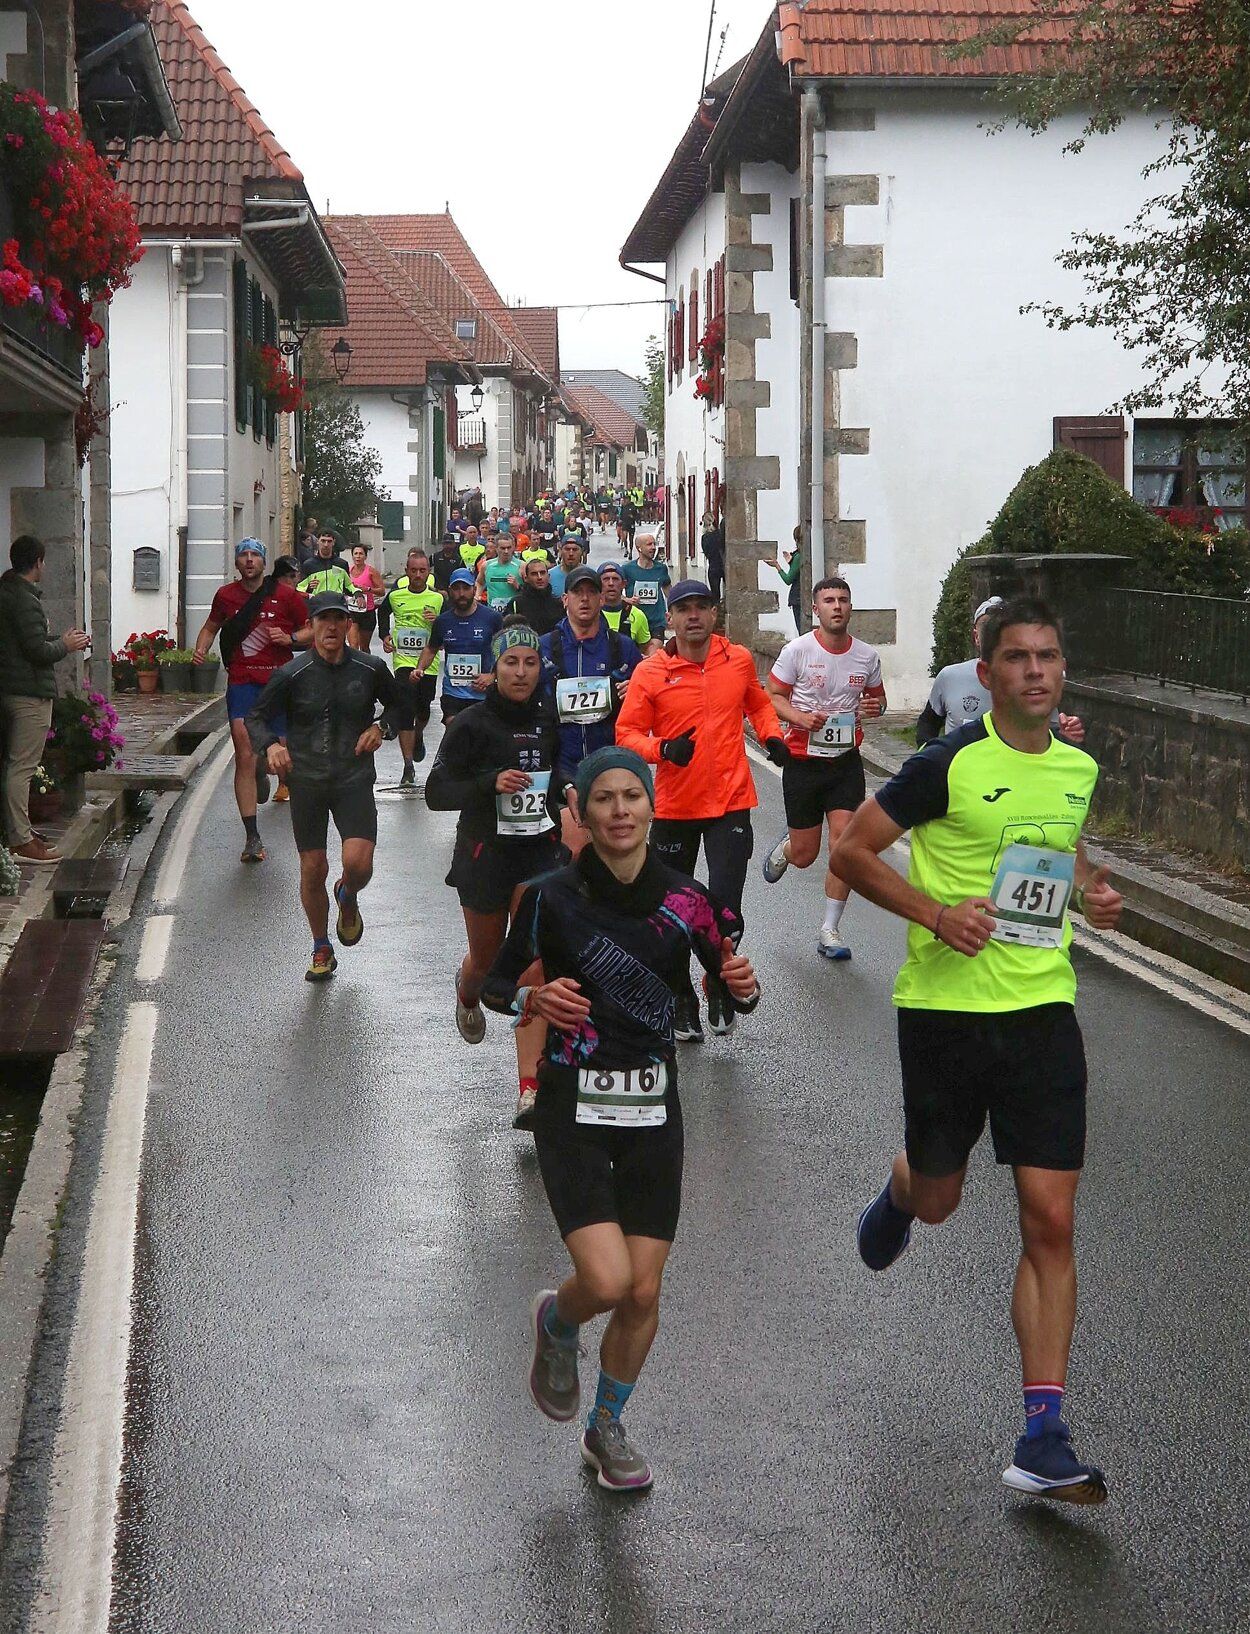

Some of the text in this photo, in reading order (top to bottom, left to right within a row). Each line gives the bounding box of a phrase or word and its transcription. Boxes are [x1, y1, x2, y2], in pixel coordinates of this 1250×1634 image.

[639, 588, 654, 597] 694
[403, 637, 422, 647] 686
[452, 664, 474, 676] 552
[567, 691, 599, 709] 727
[824, 728, 841, 742] 81
[510, 793, 546, 814] 923
[1011, 879, 1056, 913] 451
[593, 1064, 655, 1093] 816
